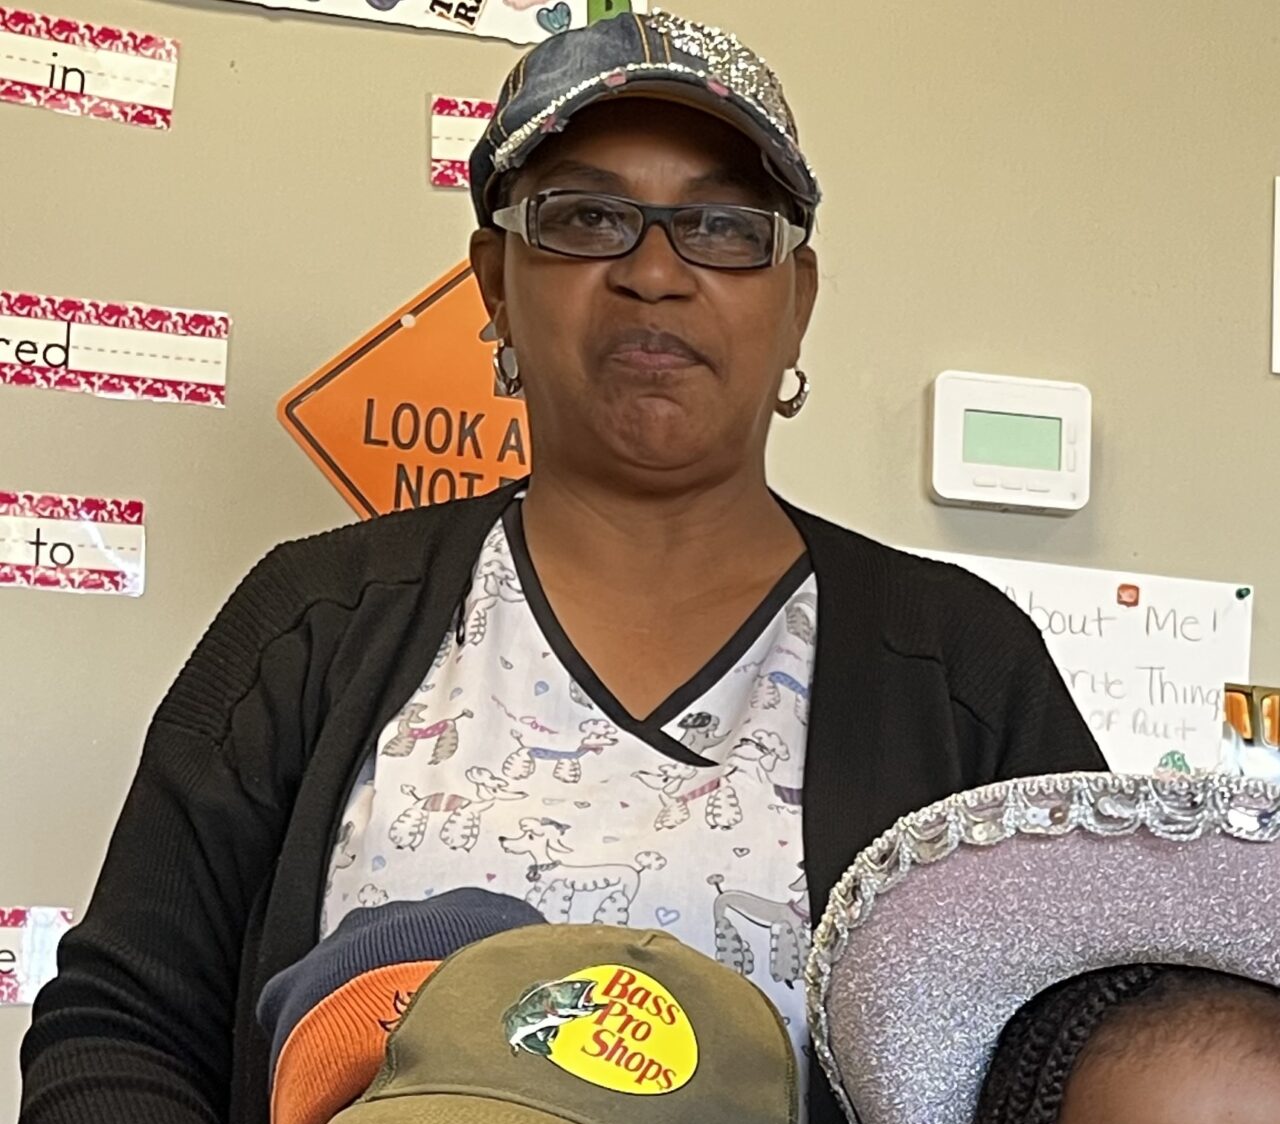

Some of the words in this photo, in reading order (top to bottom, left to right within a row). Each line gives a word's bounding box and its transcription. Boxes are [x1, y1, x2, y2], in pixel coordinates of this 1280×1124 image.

[49, 52, 86, 94] in
[363, 397, 486, 459] LOOK
[394, 463, 484, 510] NOT
[29, 528, 75, 567] to
[1146, 606, 1217, 642] Me!
[602, 968, 681, 1026] Bass
[593, 999, 652, 1042] Pro
[581, 1028, 677, 1090] Shops
